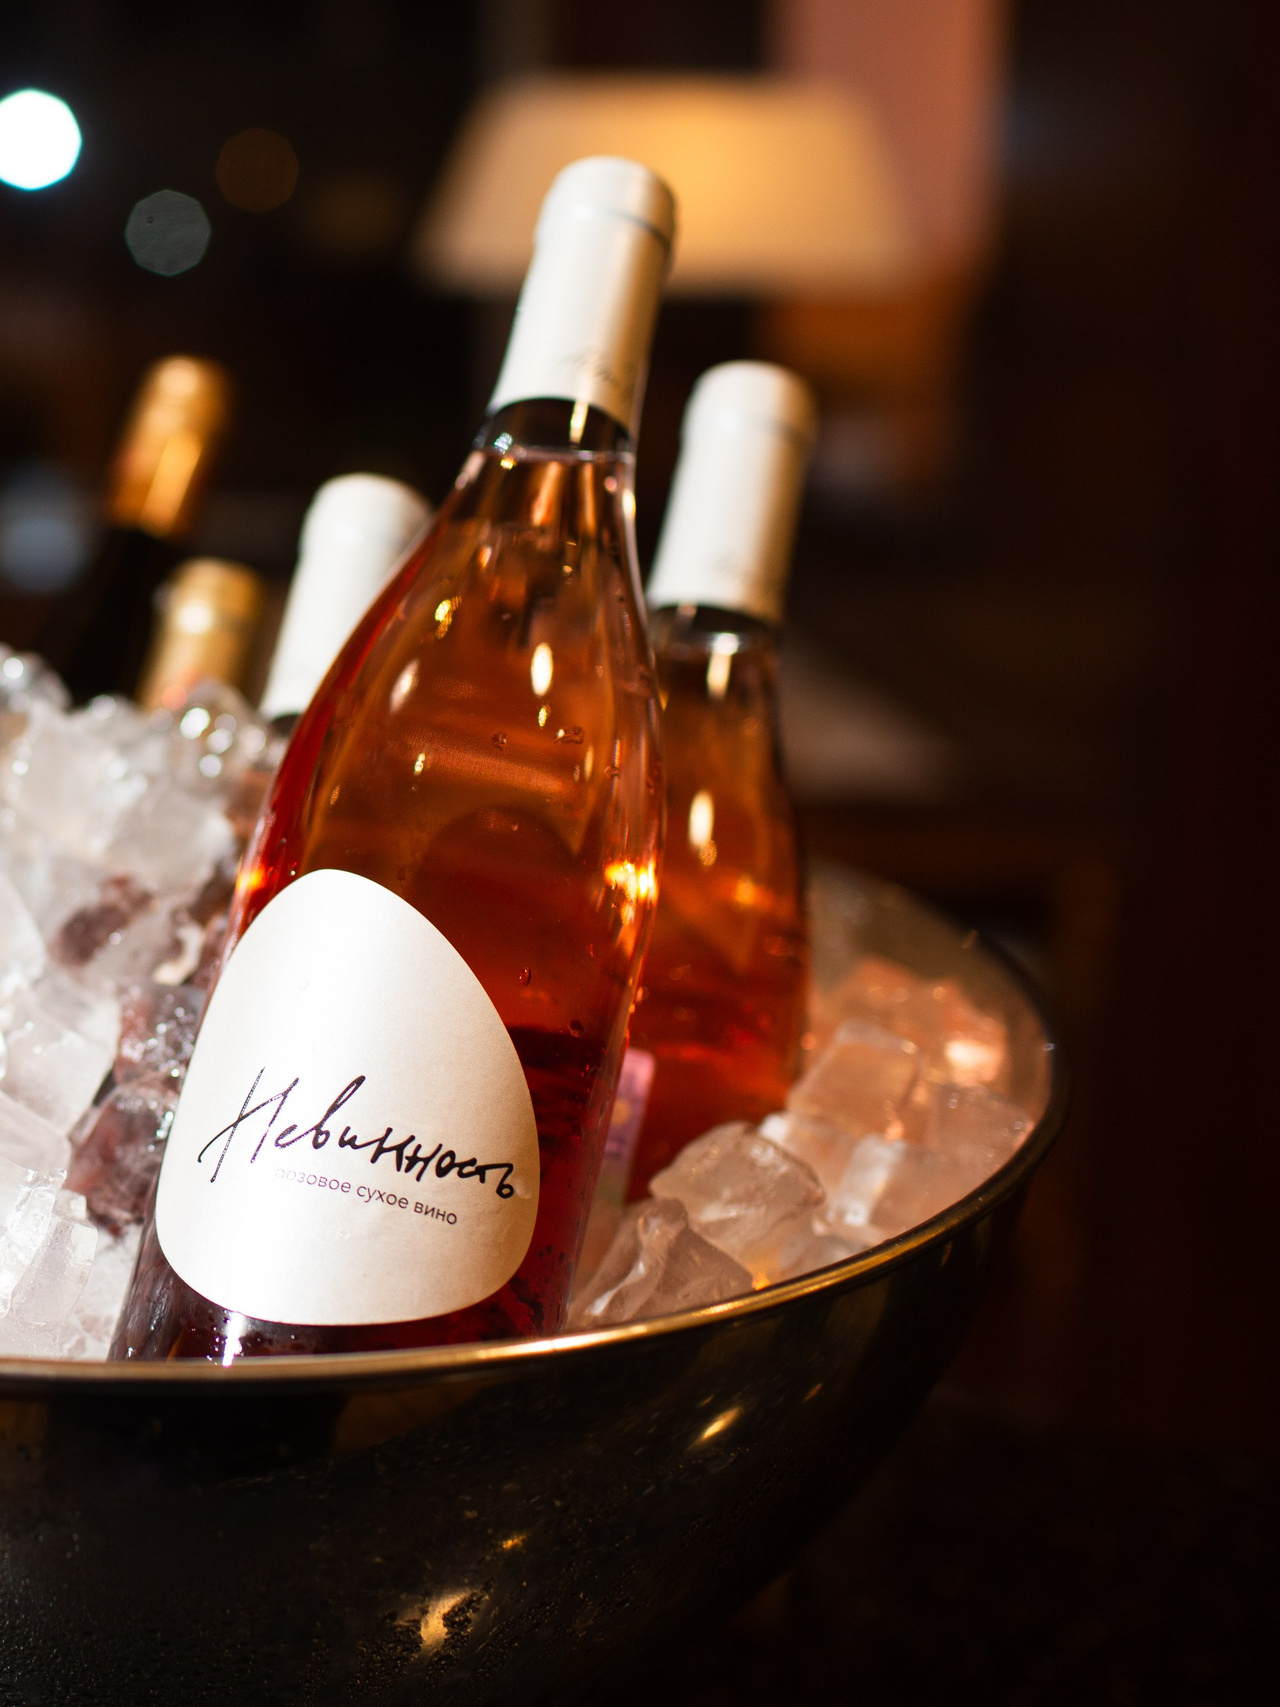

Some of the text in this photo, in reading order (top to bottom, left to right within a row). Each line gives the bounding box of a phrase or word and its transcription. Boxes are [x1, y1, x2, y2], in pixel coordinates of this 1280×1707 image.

[197, 1066, 515, 1200] Невинность
[273, 1168, 458, 1226] розовое сухое вино
